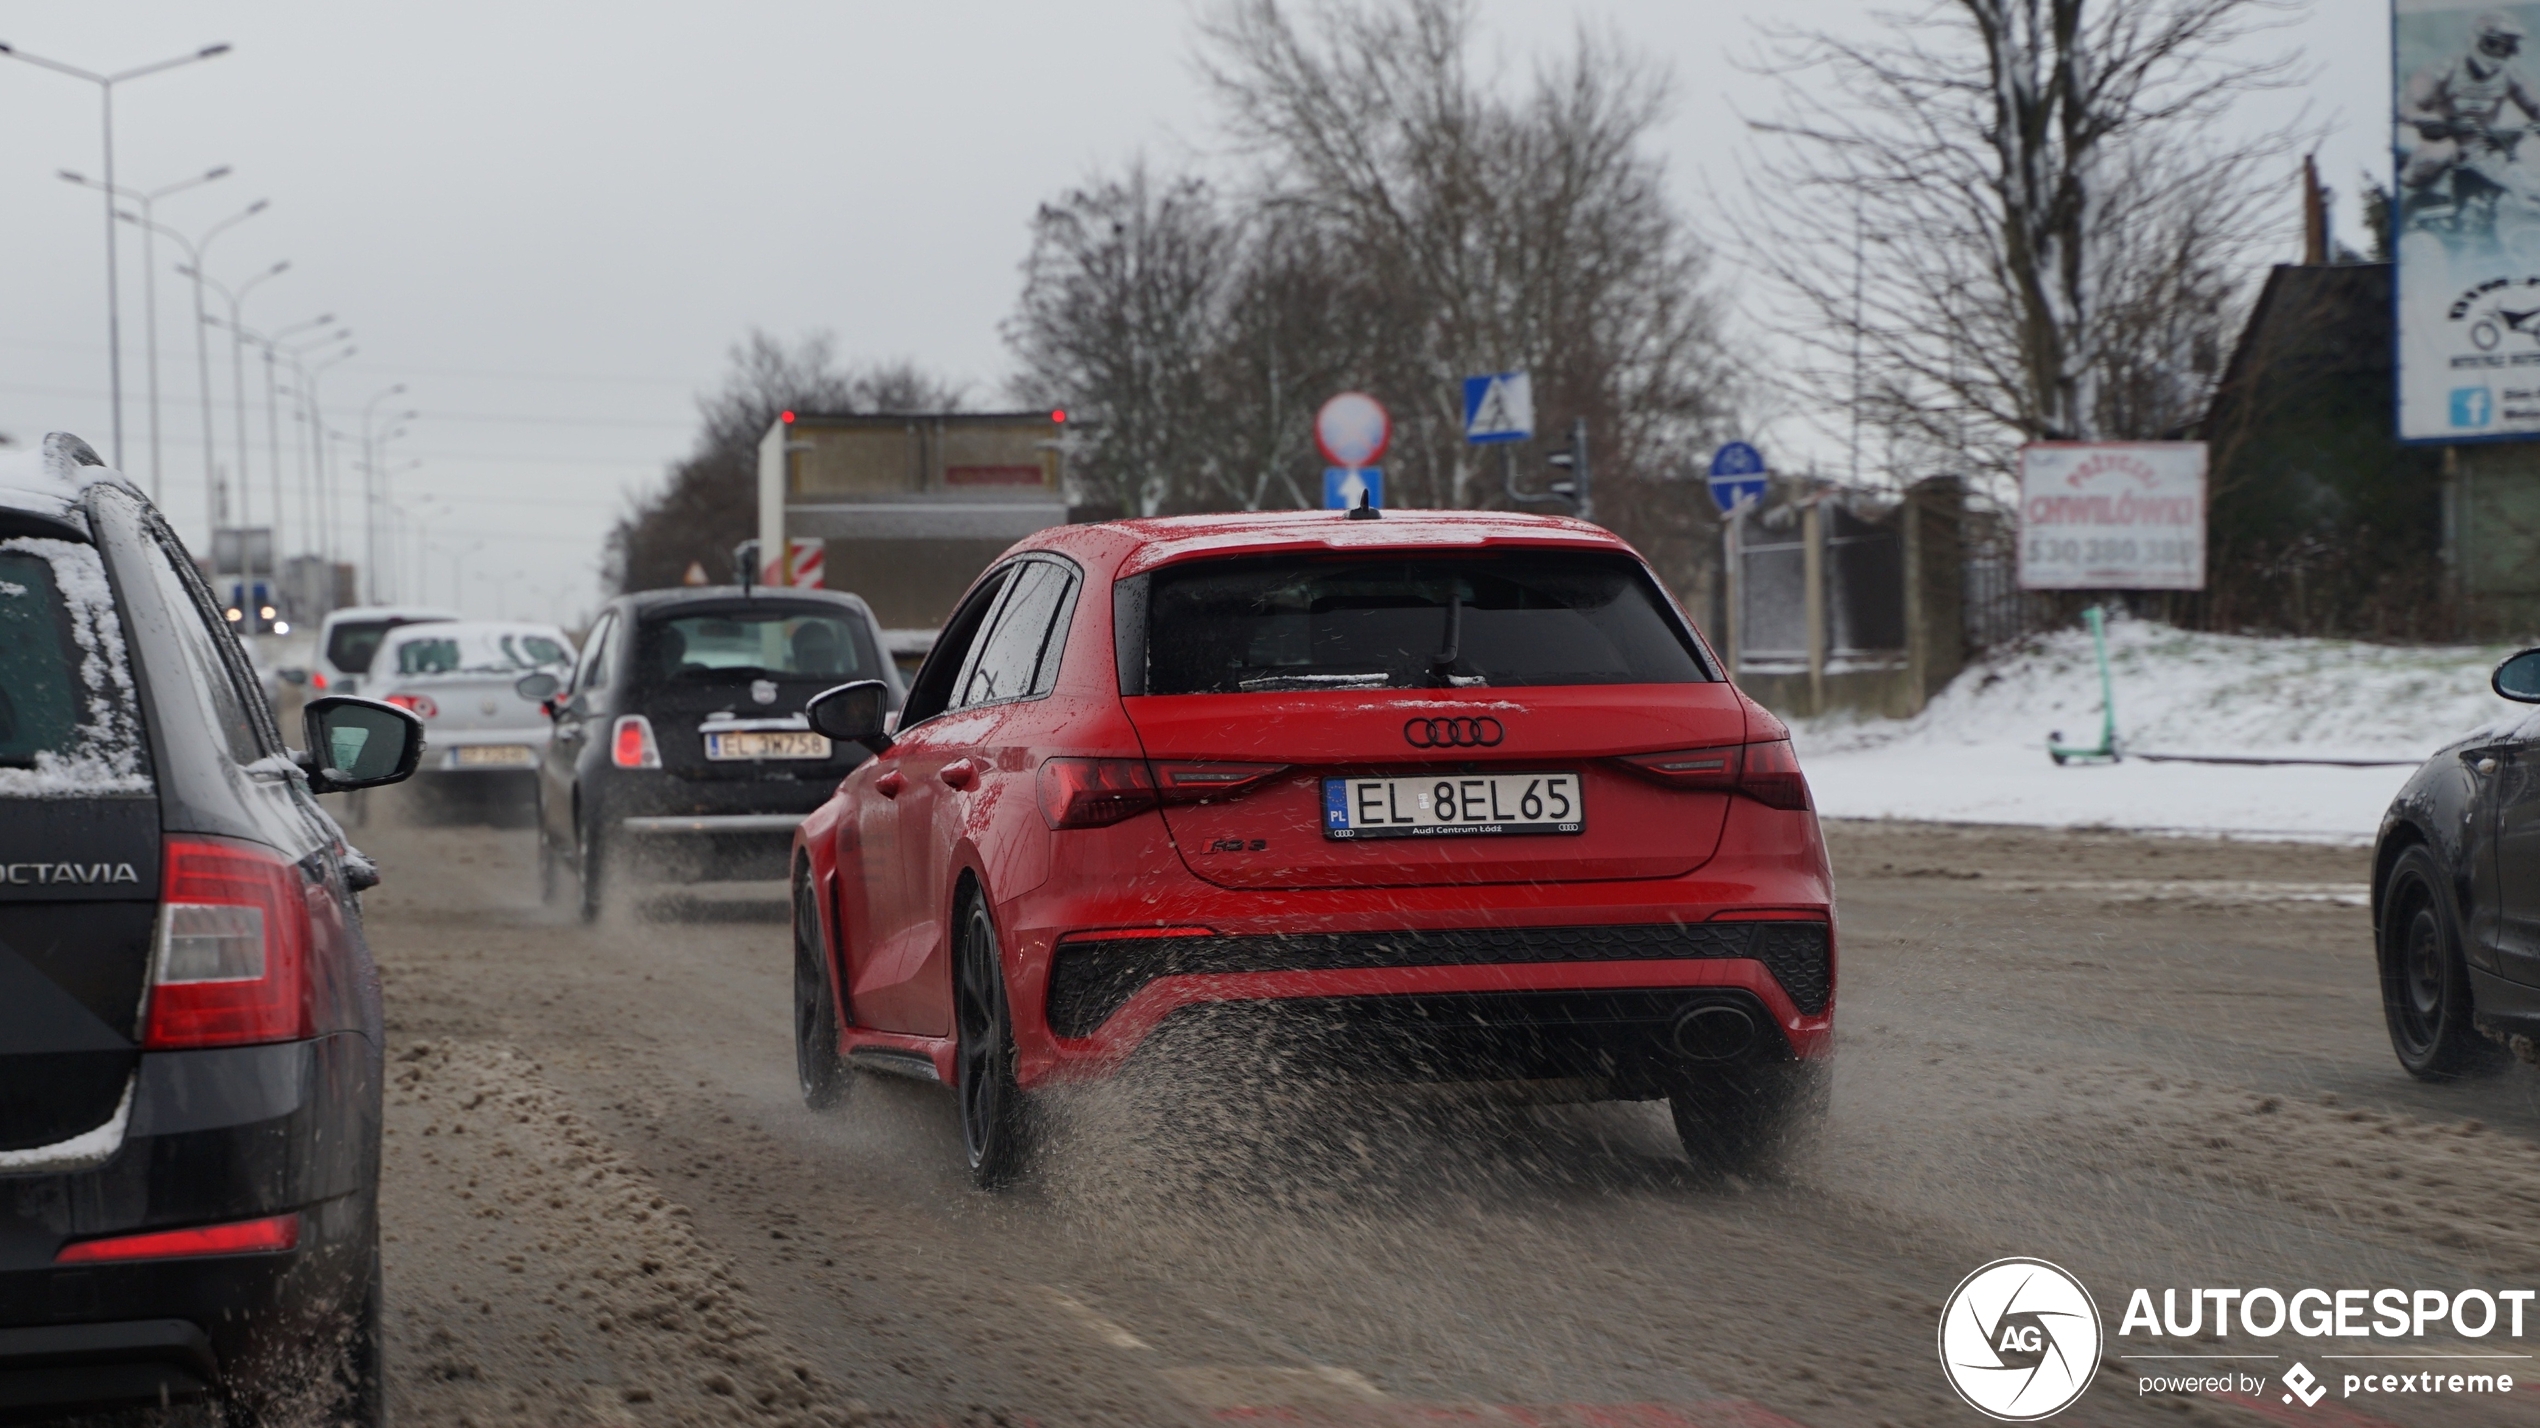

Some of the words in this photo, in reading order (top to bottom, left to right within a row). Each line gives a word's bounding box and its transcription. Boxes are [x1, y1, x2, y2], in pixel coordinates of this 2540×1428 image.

[2029, 490, 2193, 525] CHWILÓWKI
[723, 734, 749, 756] EL
[1357, 783, 1414, 825] EL
[1434, 779, 1570, 822] 8EL65
[1330, 810, 1346, 822] PL
[1436, 826, 1478, 834] Centrum
[1479, 825, 1502, 833] Łódź
[0, 863, 139, 884] CTAVIA
